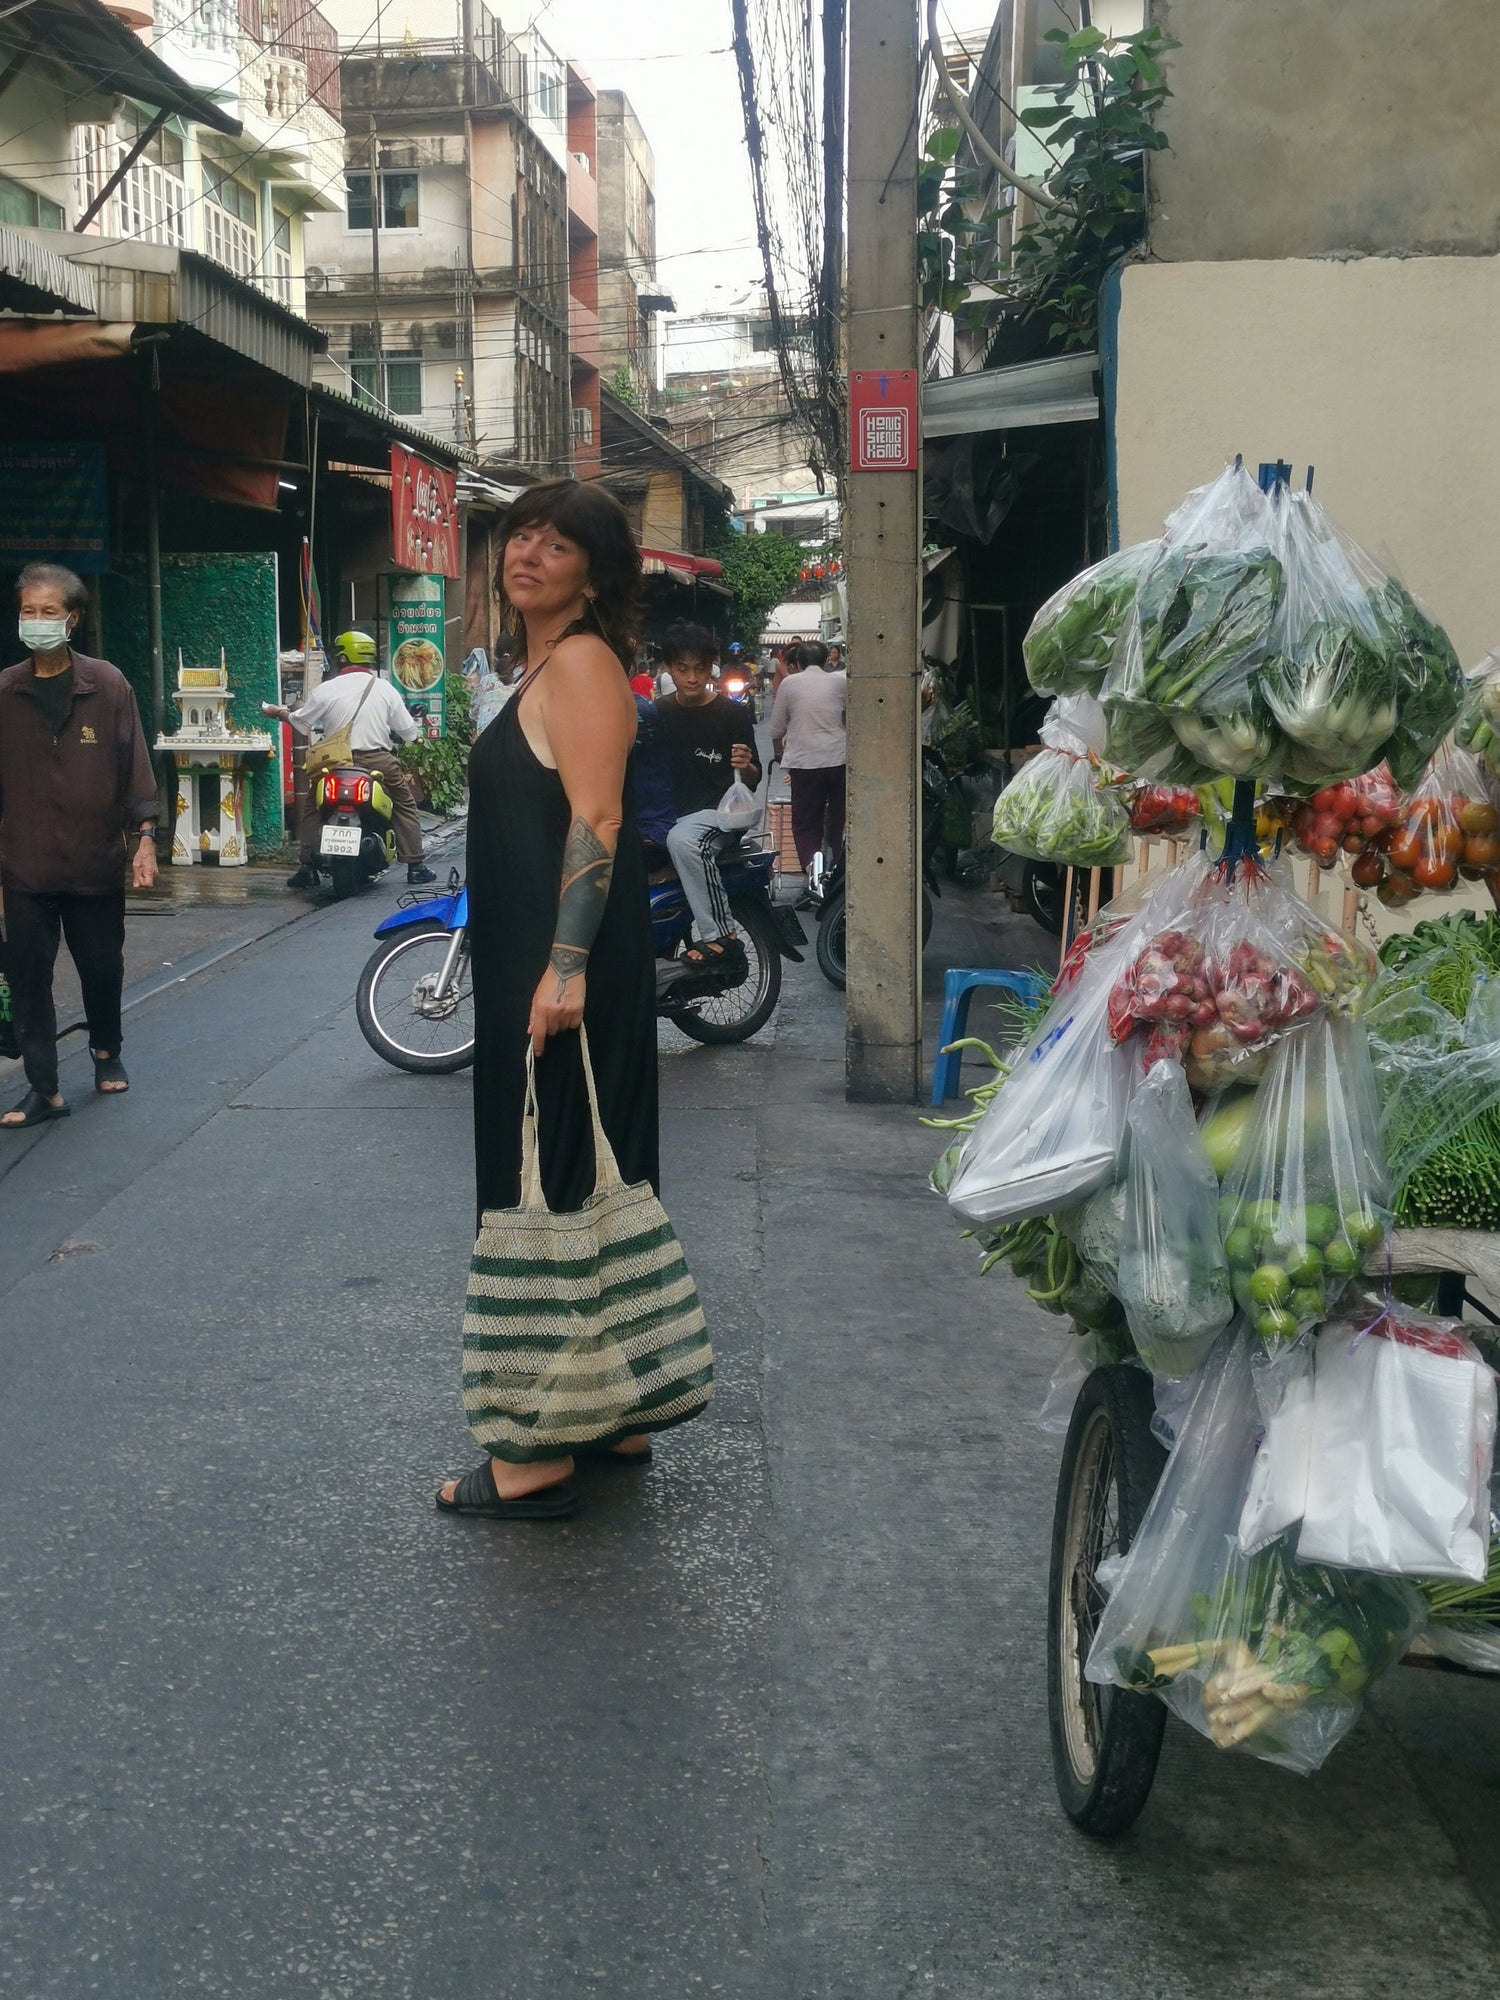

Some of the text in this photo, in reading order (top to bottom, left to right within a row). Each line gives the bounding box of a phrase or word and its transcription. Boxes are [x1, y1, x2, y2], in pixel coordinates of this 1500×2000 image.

[867, 416, 901, 431] HONG
[867, 431, 901, 443] SIENG
[867, 444, 902, 458] KONG
[327, 845, 353, 854] 3902
